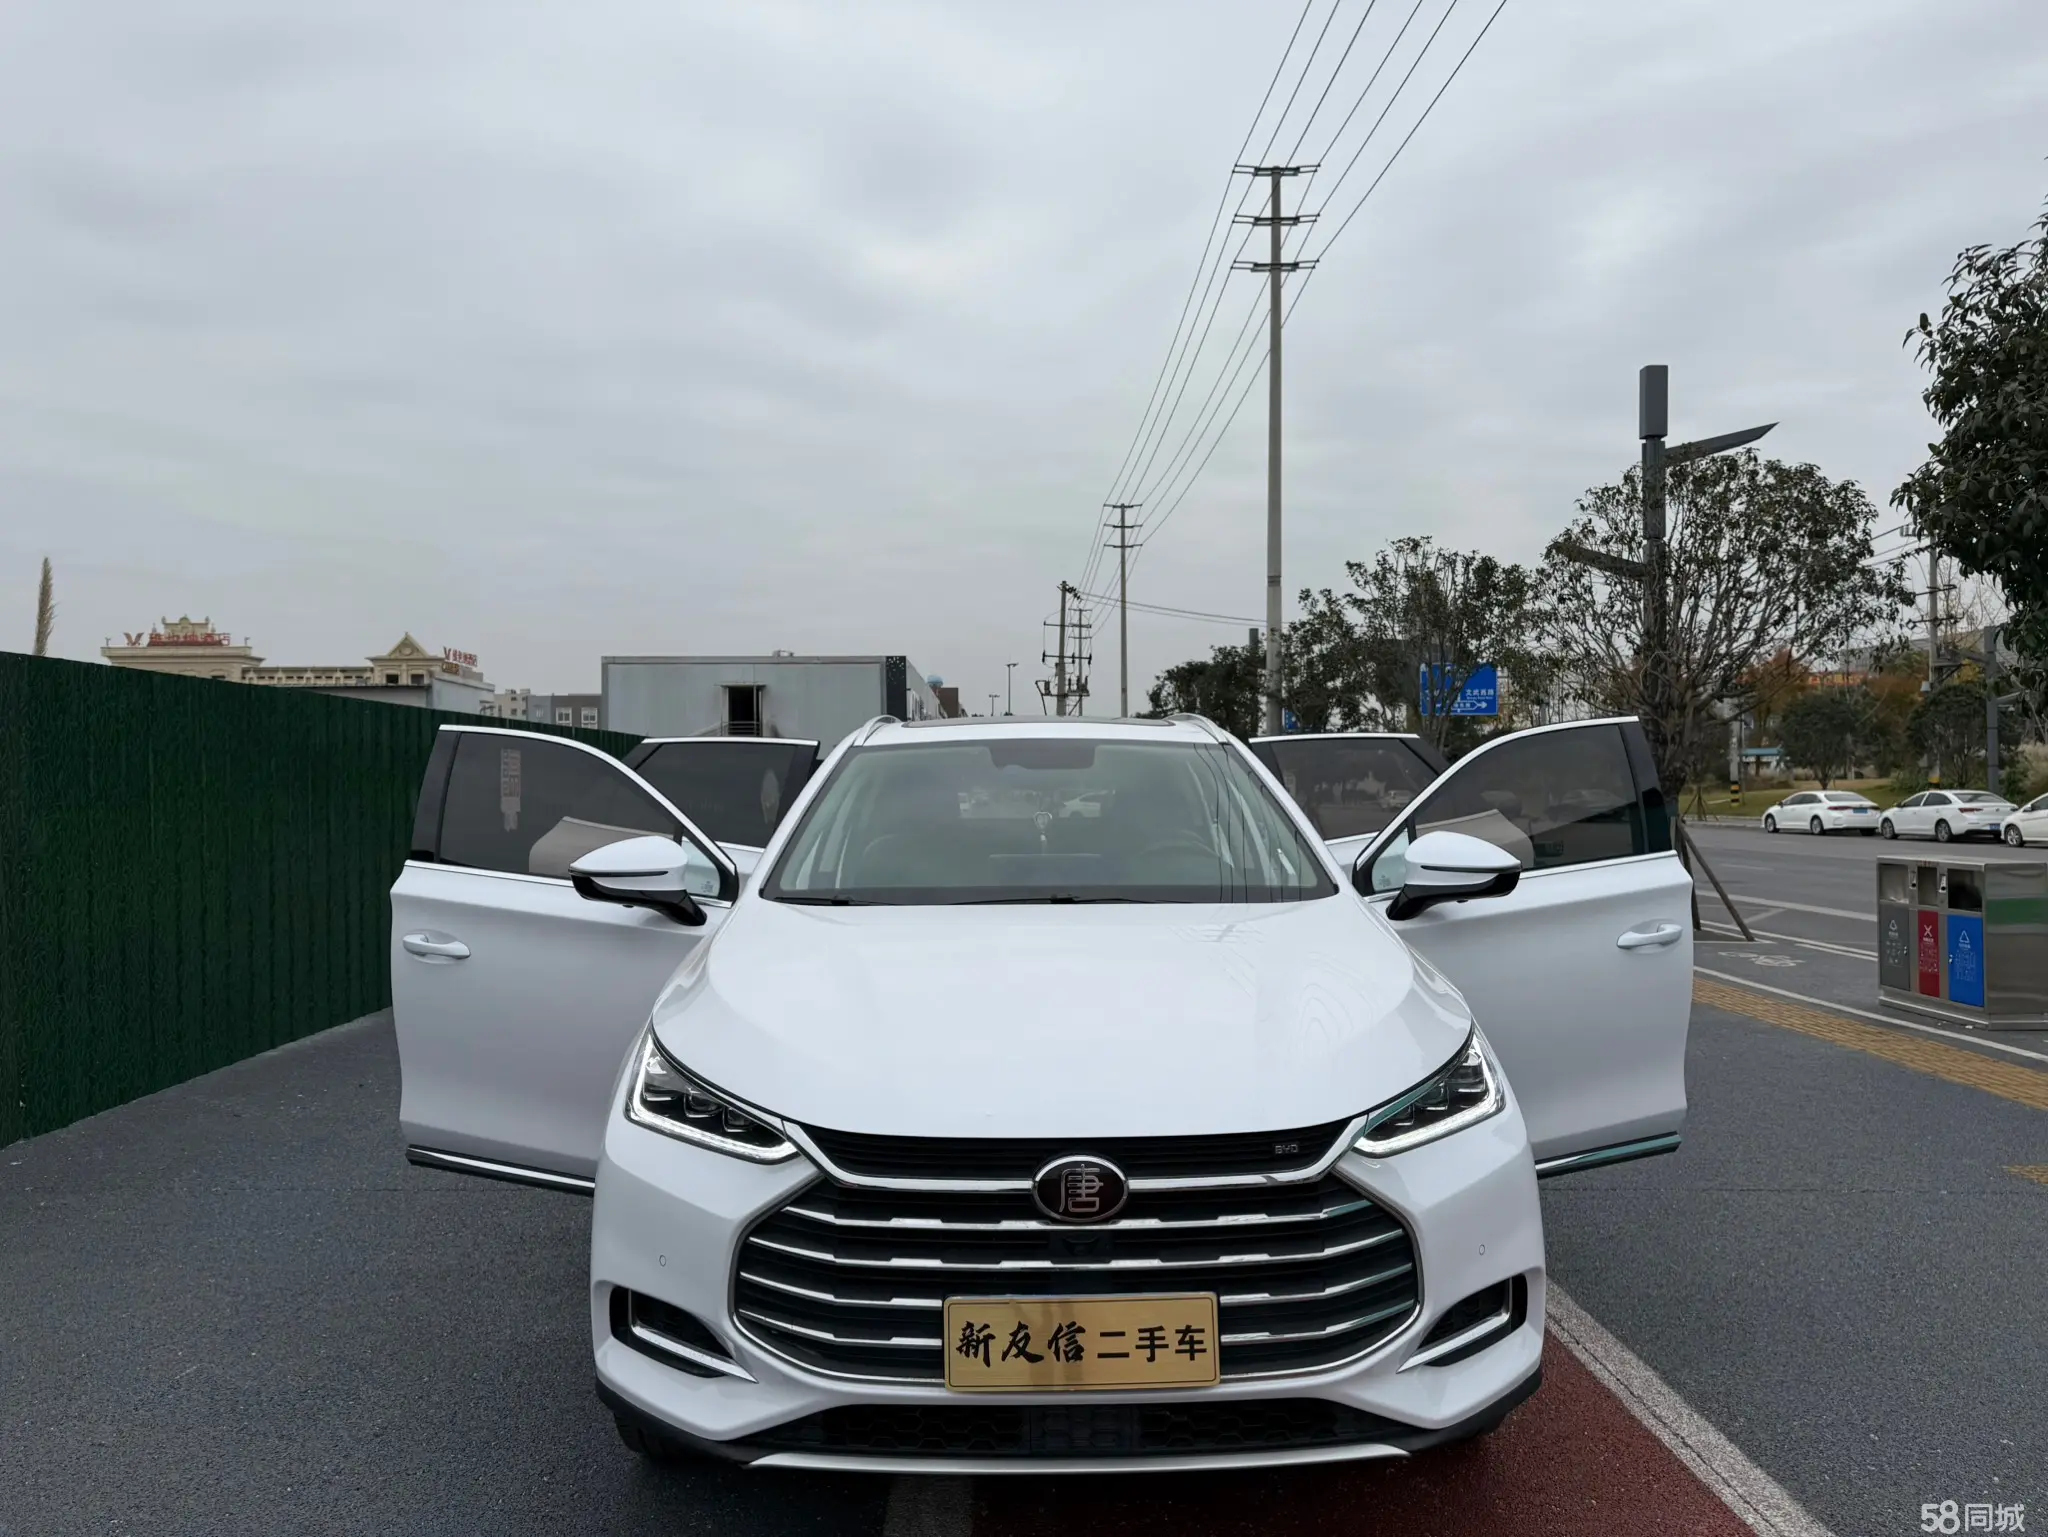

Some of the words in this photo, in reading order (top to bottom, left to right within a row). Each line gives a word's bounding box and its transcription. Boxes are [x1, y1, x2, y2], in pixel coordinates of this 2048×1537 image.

[1274, 1144, 1299, 1154] BYD
[1059, 1164, 1104, 1213] 唐
[955, 1320, 1208, 1368] 新友信二手车
